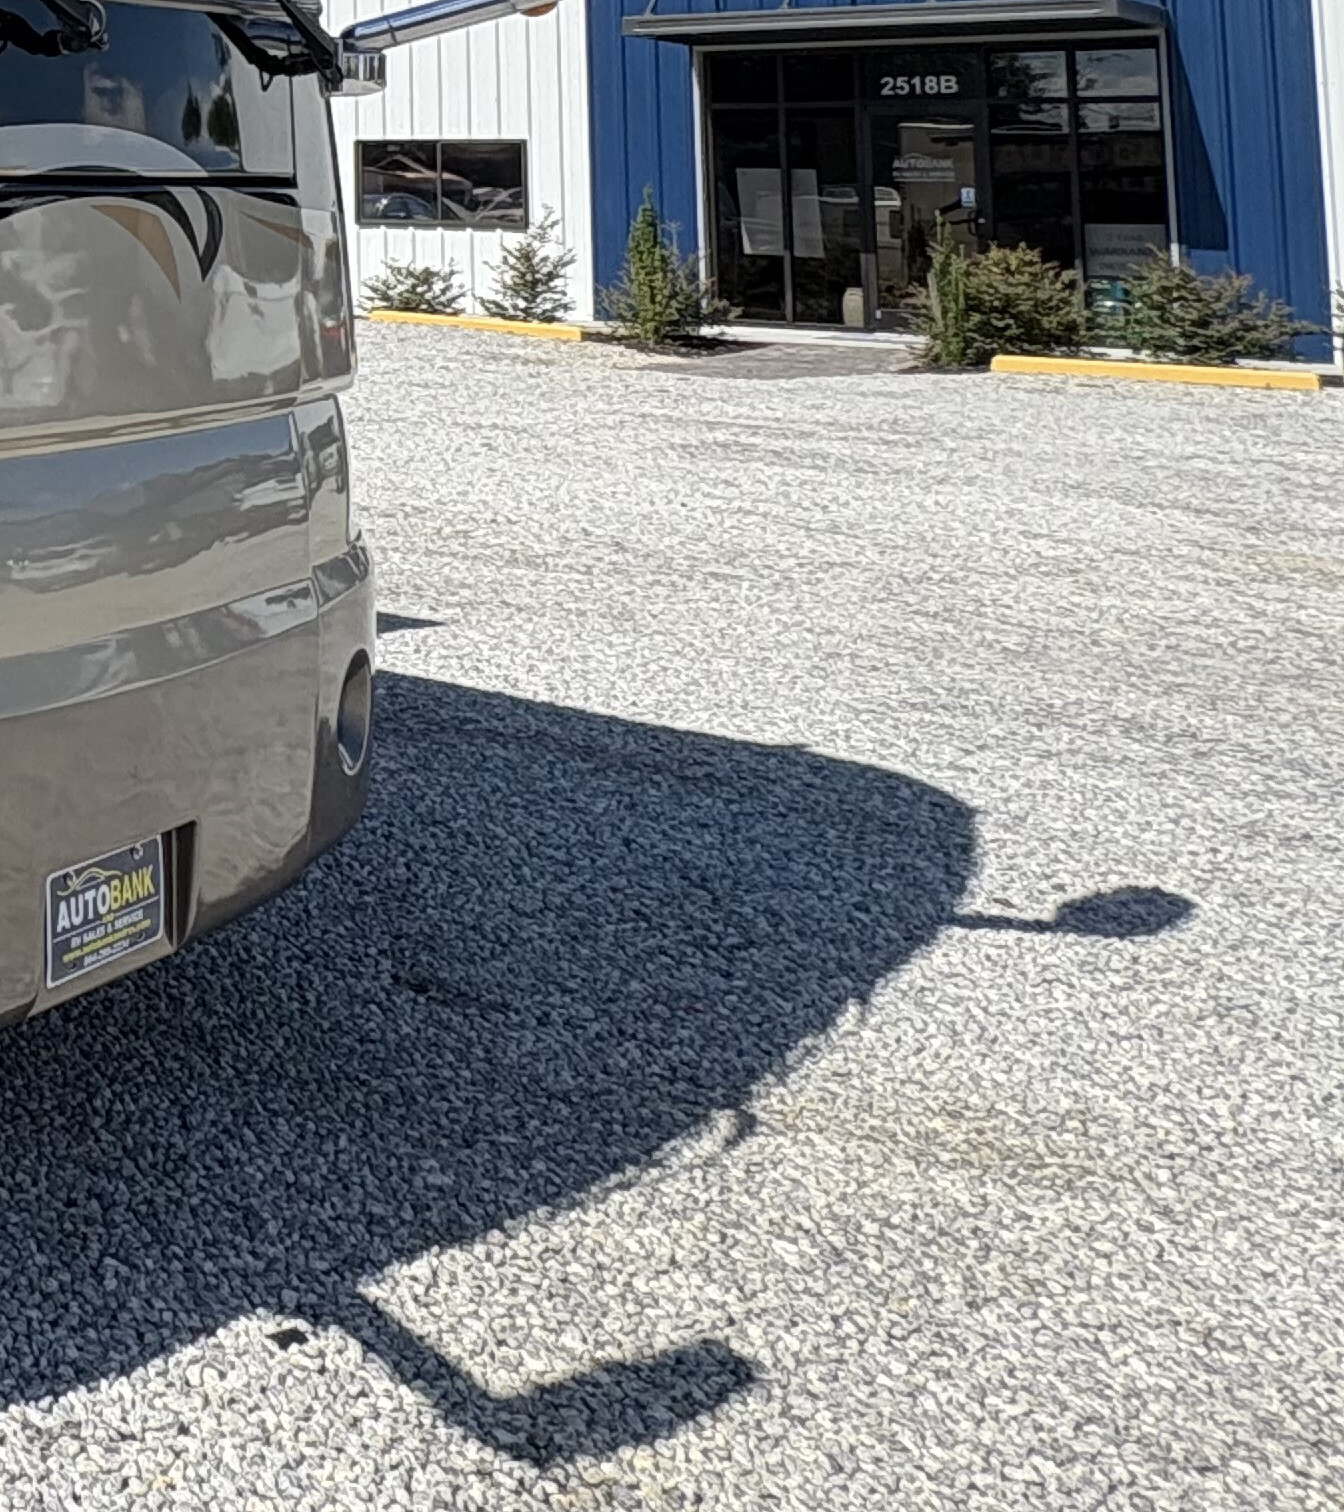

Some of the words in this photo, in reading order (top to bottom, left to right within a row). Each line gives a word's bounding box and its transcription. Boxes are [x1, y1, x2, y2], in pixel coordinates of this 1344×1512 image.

[880, 75, 959, 96] 2518B
[1089, 246, 1158, 258] WARRAN
[56, 865, 155, 933] AUTOBANK
